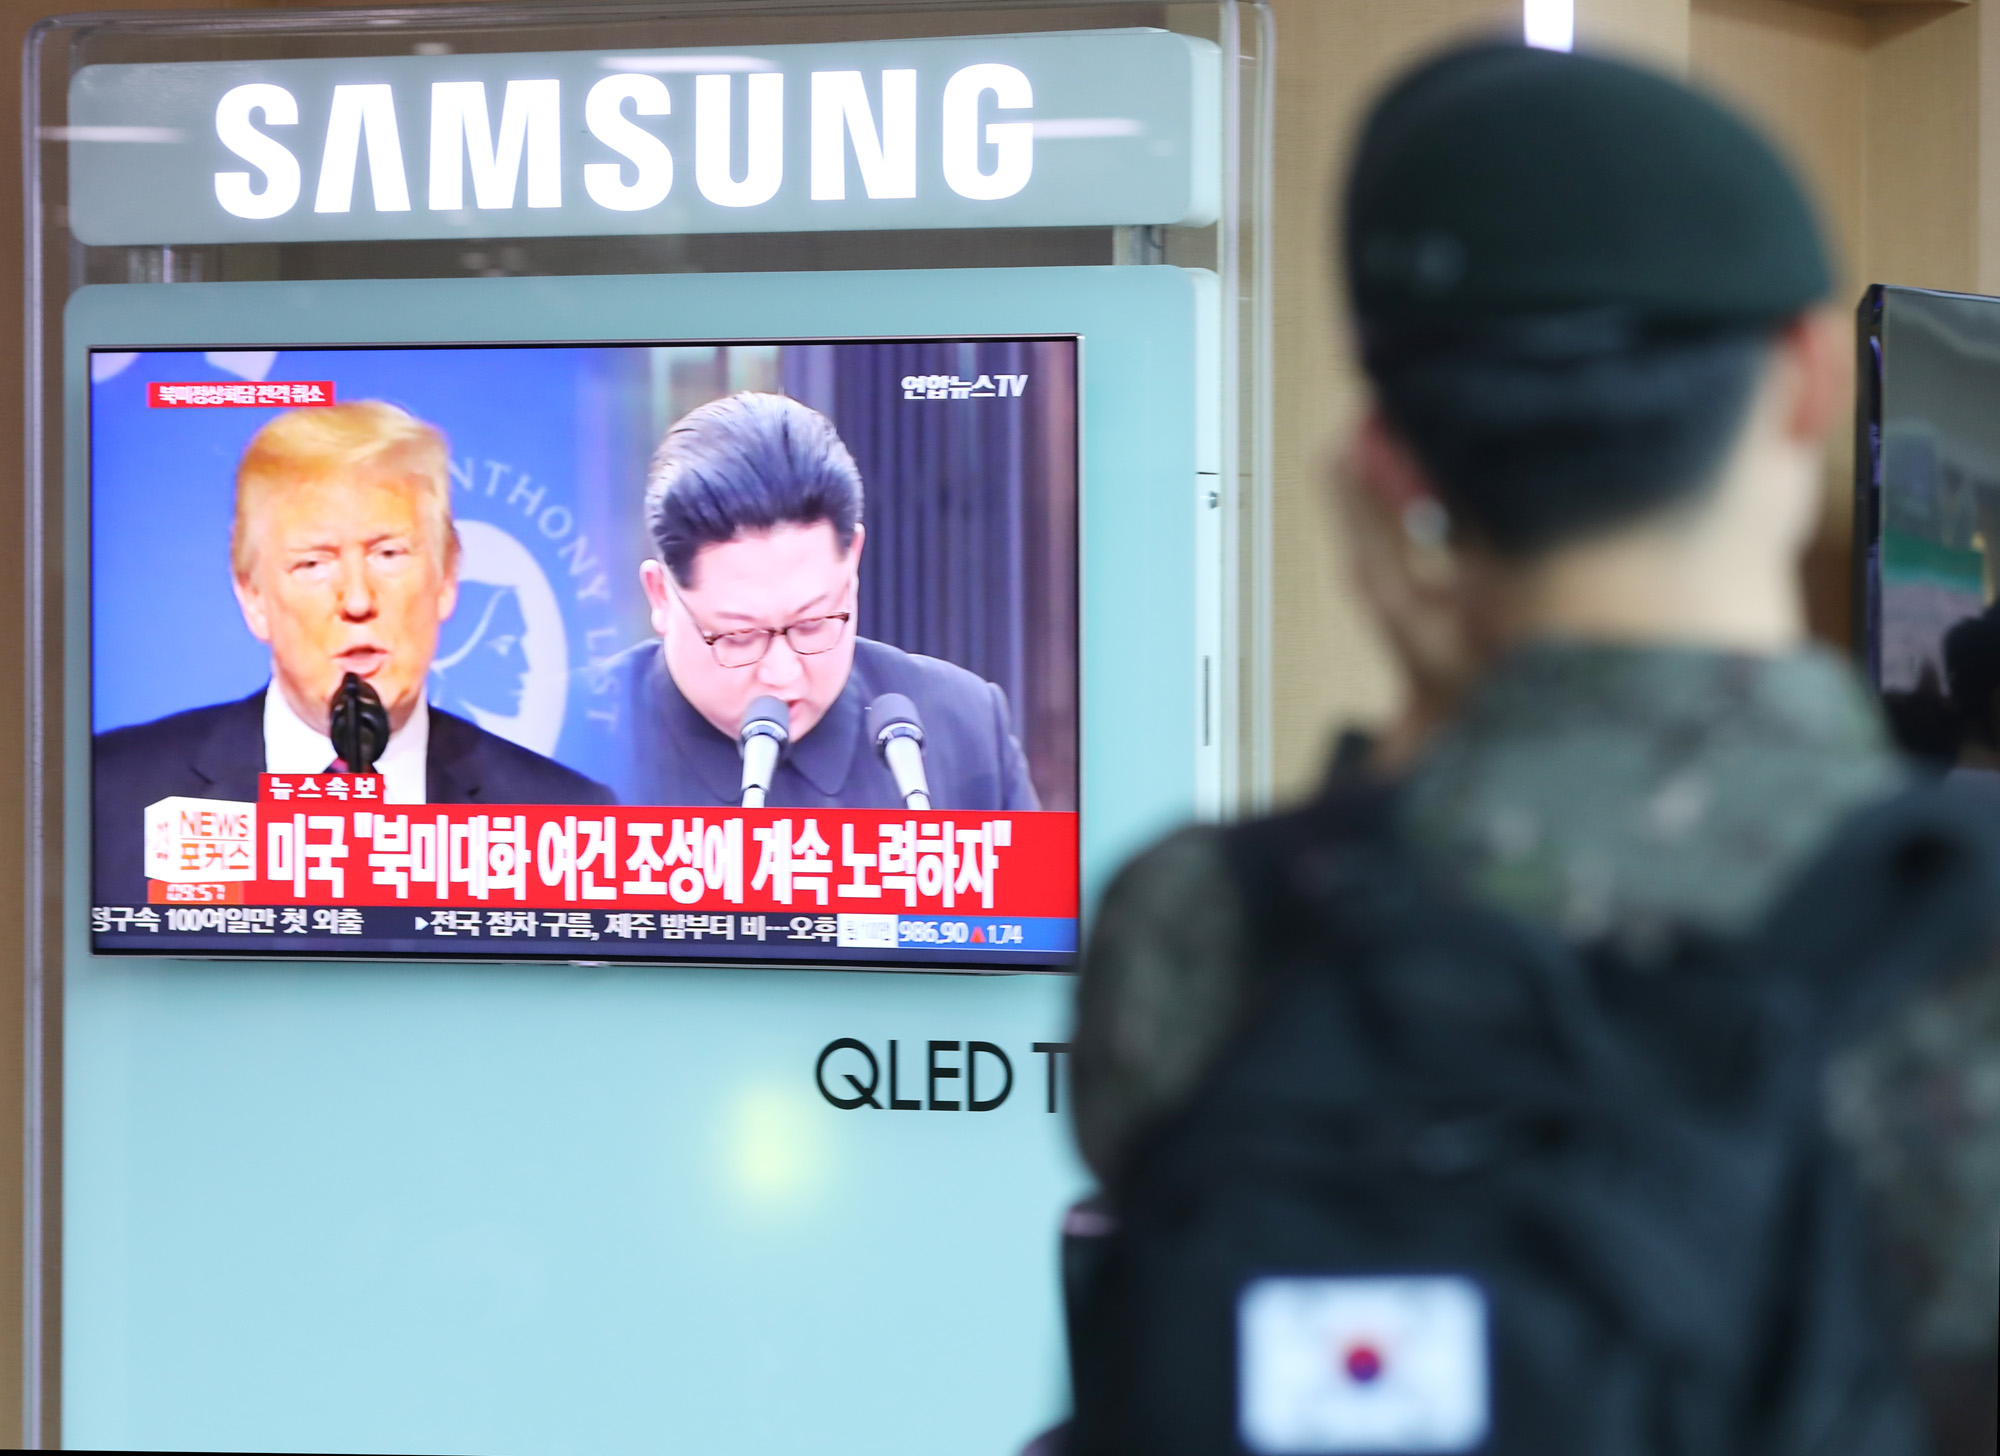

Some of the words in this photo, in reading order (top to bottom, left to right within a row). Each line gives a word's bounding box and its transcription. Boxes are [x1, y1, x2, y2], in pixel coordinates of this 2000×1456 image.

[214, 63, 1034, 220] SAMSUNG
[158, 385, 256, 405] 북미정상회담
[255, 385, 291, 404] 전격
[291, 384, 326, 404] 취소
[901, 374, 1029, 400] 연합뉴스TV
[450, 457, 612, 602] NTHONY
[269, 777, 378, 800] 뉴스속보
[180, 810, 249, 838] NEWS
[180, 843, 249, 870] 포커스
[267, 813, 349, 898] 미국
[353, 812, 531, 900] "북미대화
[537, 815, 618, 901] 여건
[623, 817, 744, 904] 조성에
[750, 818, 833, 905] 계속
[837, 820, 1012, 908] 노력하자"
[165, 907, 277, 933] 100여일만
[280, 908, 308, 934] 첫
[312, 909, 364, 934] 외출
[429, 910, 482, 936] 전국
[485, 911, 539, 937] 점차
[540, 912, 600, 941] 구름,
[604, 912, 657, 938] 제주
[660, 914, 735, 940] 밤부터
[814, 1037, 1014, 1112] QLED
[1031, 1041, 1073, 1114] T
